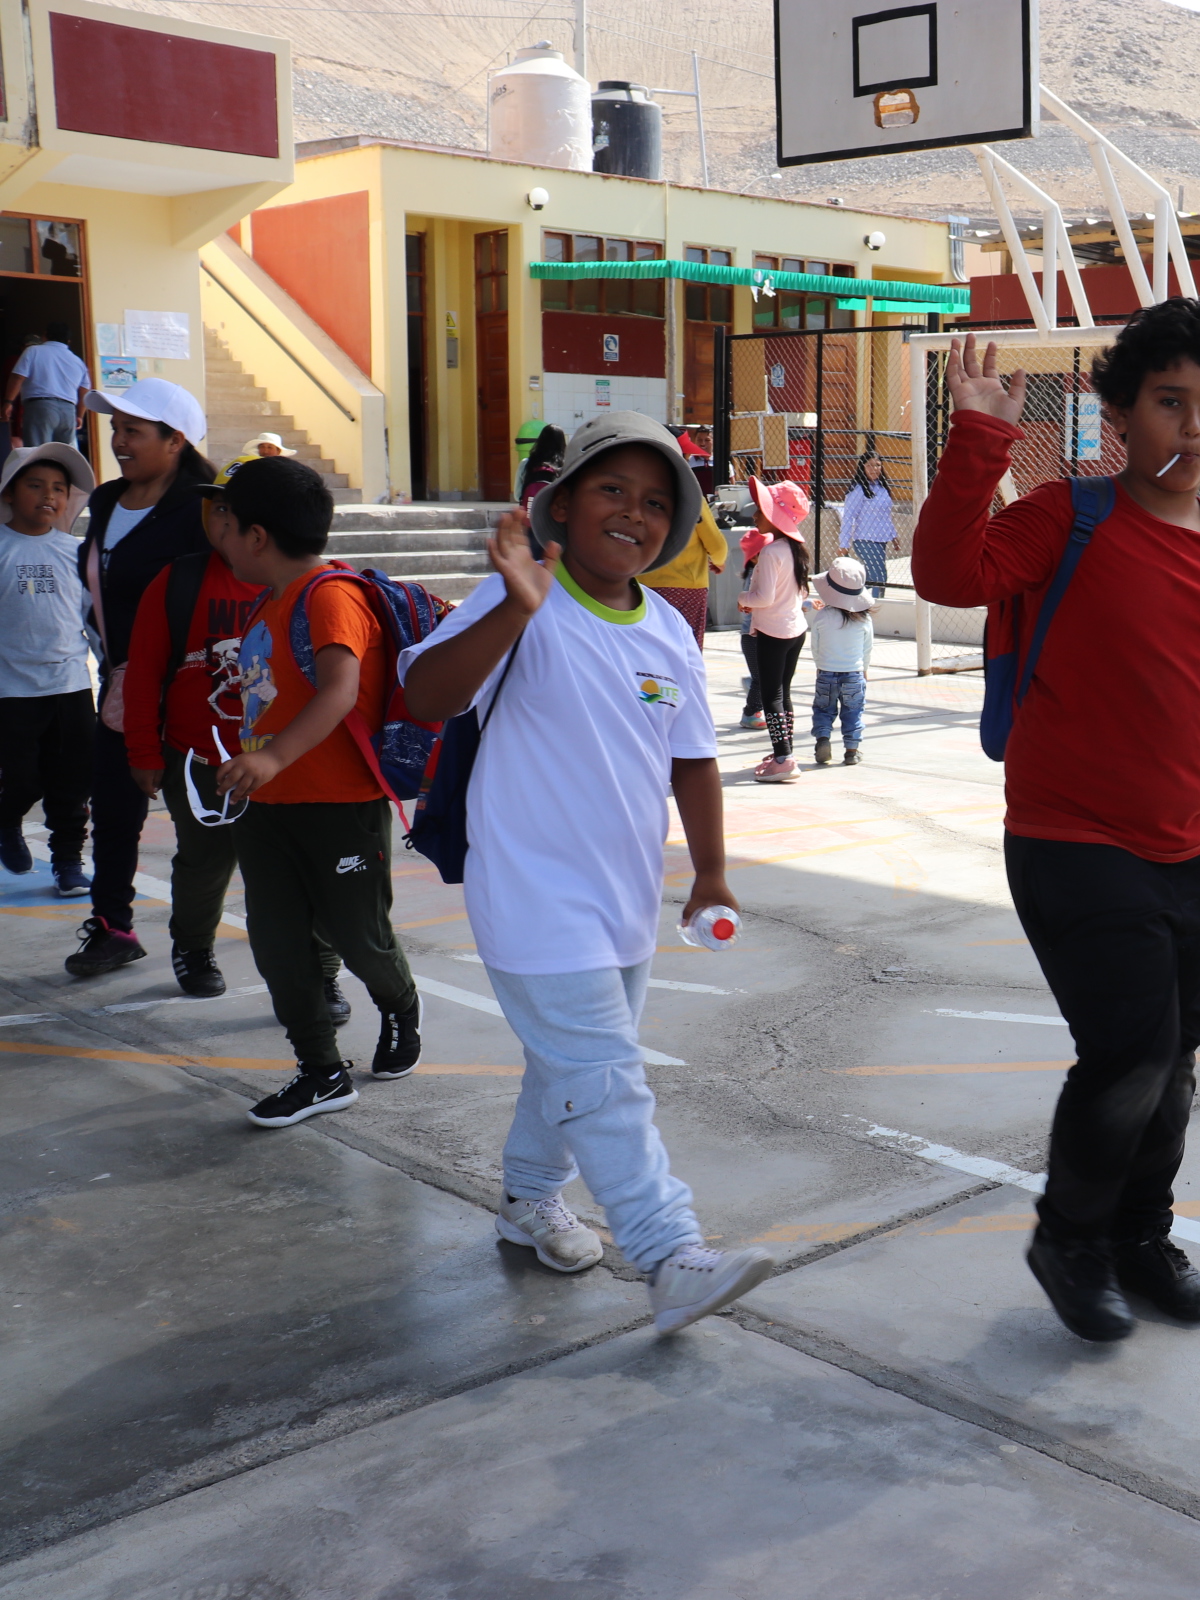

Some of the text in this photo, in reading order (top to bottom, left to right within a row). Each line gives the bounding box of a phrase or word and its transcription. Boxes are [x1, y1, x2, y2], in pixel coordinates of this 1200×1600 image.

[1068, 403, 1097, 415] SLIDA
[16, 564, 54, 579] FREE
[660, 686, 679, 702] ITE
[339, 855, 361, 867] NIKE
[353, 864, 368, 873] AIR
